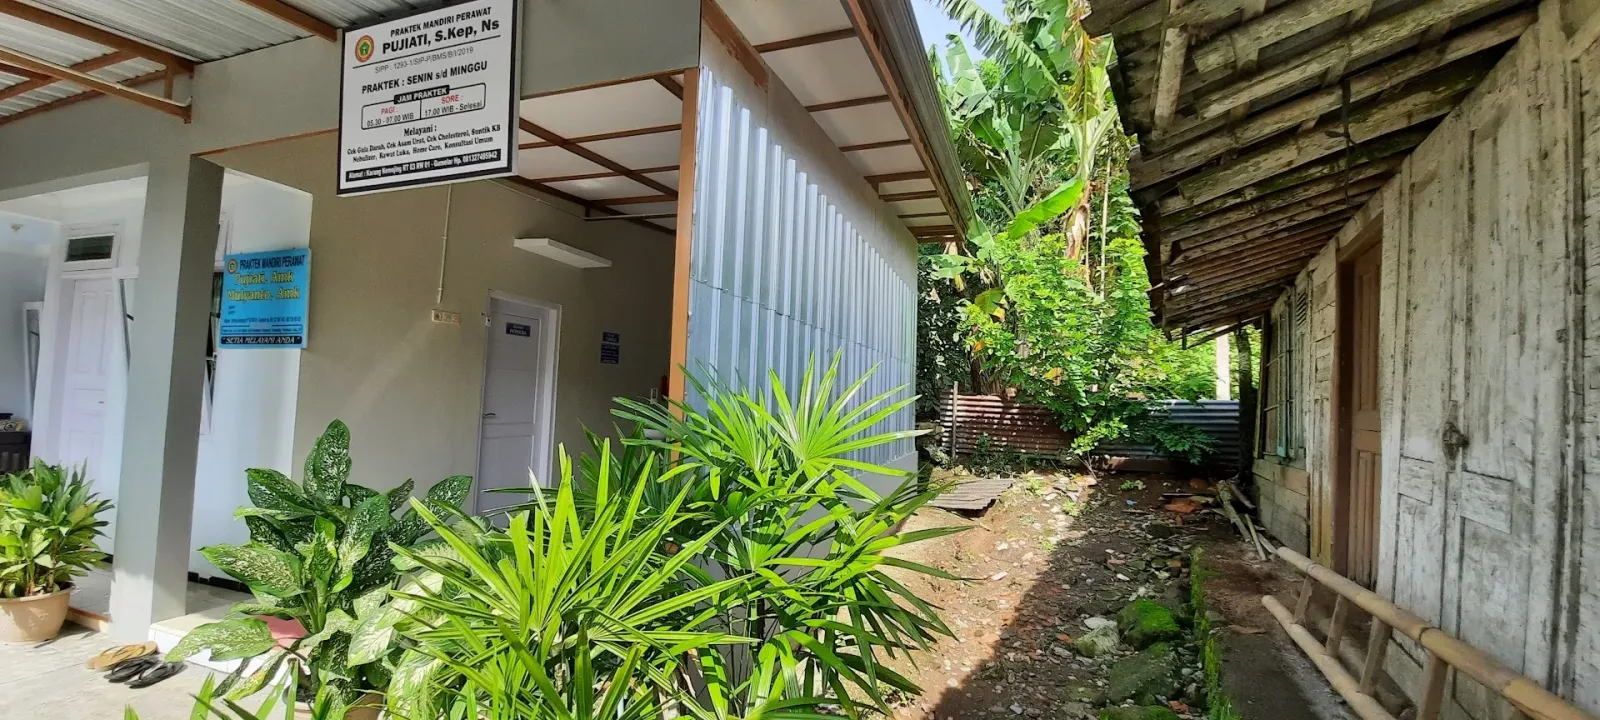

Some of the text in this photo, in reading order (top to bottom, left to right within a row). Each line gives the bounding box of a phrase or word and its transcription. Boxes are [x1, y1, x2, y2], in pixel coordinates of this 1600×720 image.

[390, 7, 491, 37] PRAKTEK MANDIRI PERAWAT
[383, 19, 500, 54] PUJIATI, S.Kep, Ns
[362, 78, 400, 95] PRAKTEK
[406, 72, 433, 86] SENIN
[435, 69, 448, 80] s/d
[449, 61, 488, 77] MINGGU
[398, 87, 448, 102] JAM PRAKTEK
[441, 94, 460, 104] SORE
[380, 106, 395, 115] PAGI
[424, 107, 440, 117] 17.00
[441, 105, 454, 114] WIB
[459, 99, 483, 111] Selesai
[401, 112, 414, 121] WIB
[386, 141, 396, 149] Cek
[471, 126, 491, 136] Suntik
[491, 124, 501, 132] KB
[403, 124, 434, 137] Melayani
[444, 139, 473, 149] Konsultasi
[239, 254, 306, 270] PRAKTEK MANDIRI PERAWAT
